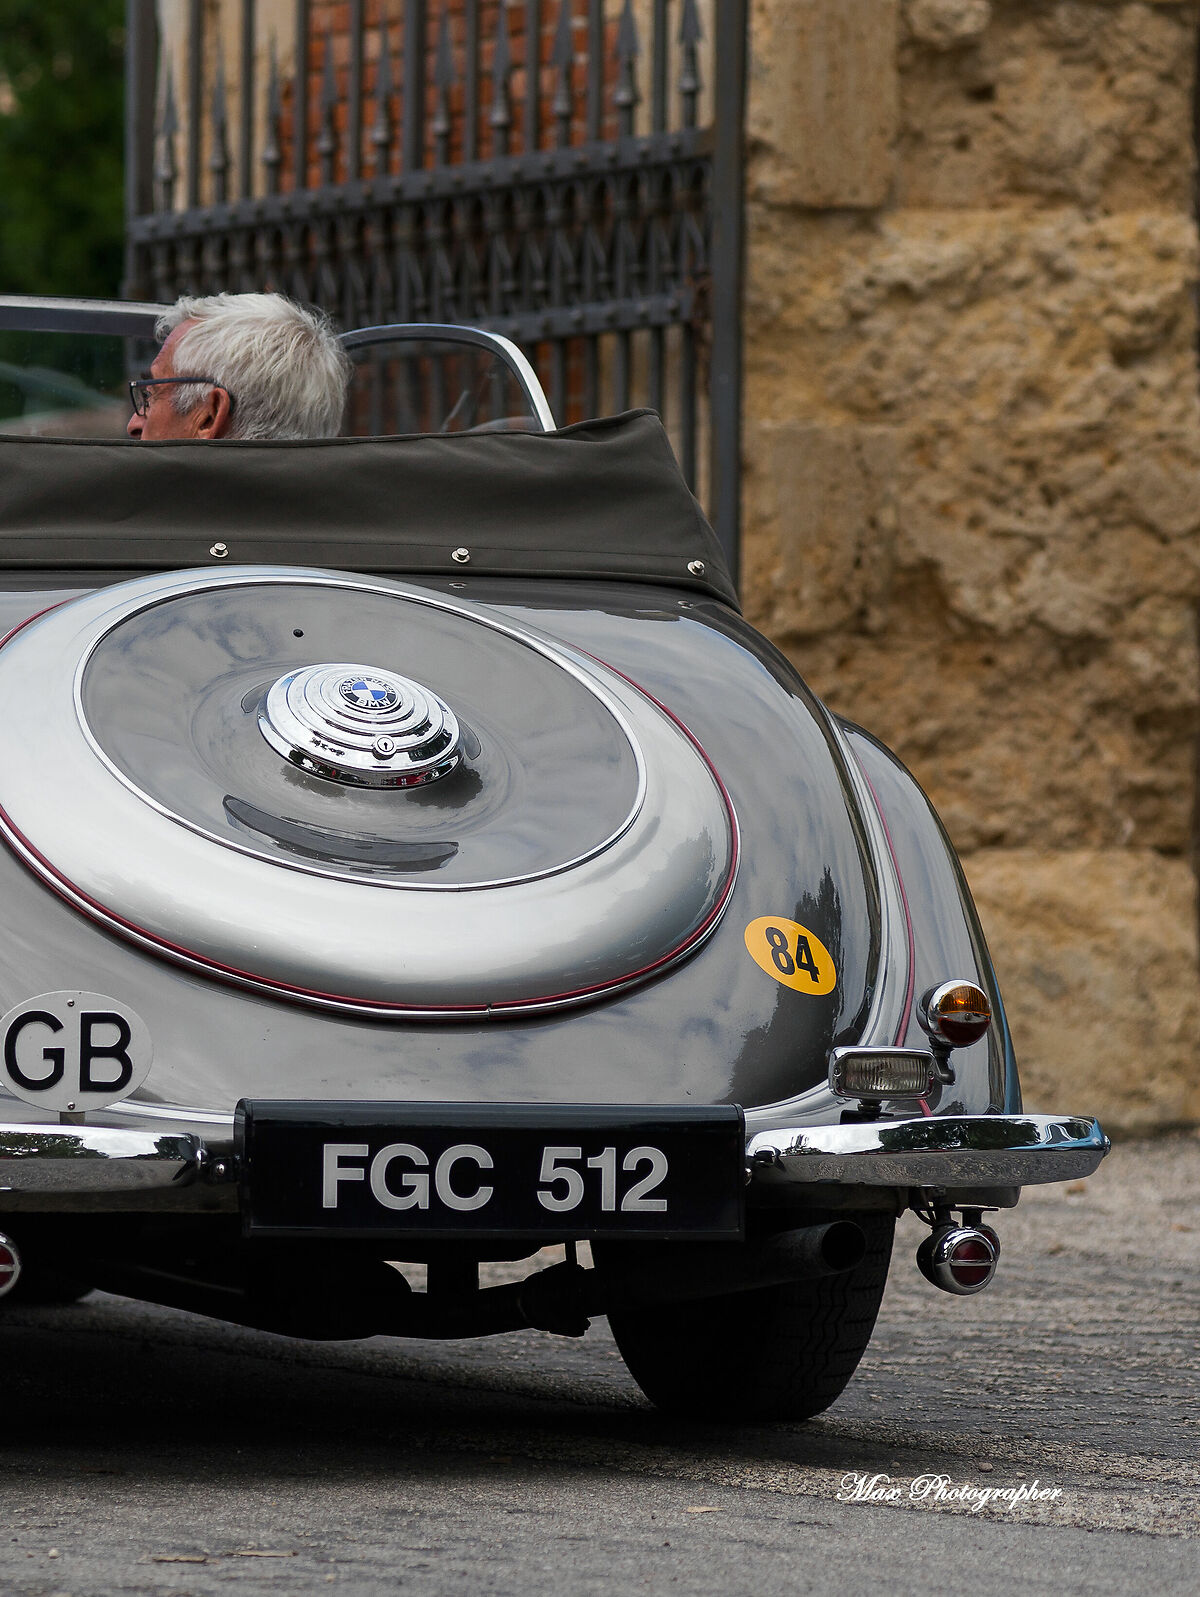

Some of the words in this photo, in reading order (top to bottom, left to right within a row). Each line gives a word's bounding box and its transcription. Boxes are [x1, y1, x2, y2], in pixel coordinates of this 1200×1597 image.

[357, 698, 391, 708] BMW
[765, 926, 820, 984] 84
[4, 1010, 133, 1092] GB
[322, 1143, 494, 1211] FGC
[536, 1146, 669, 1212] 512
